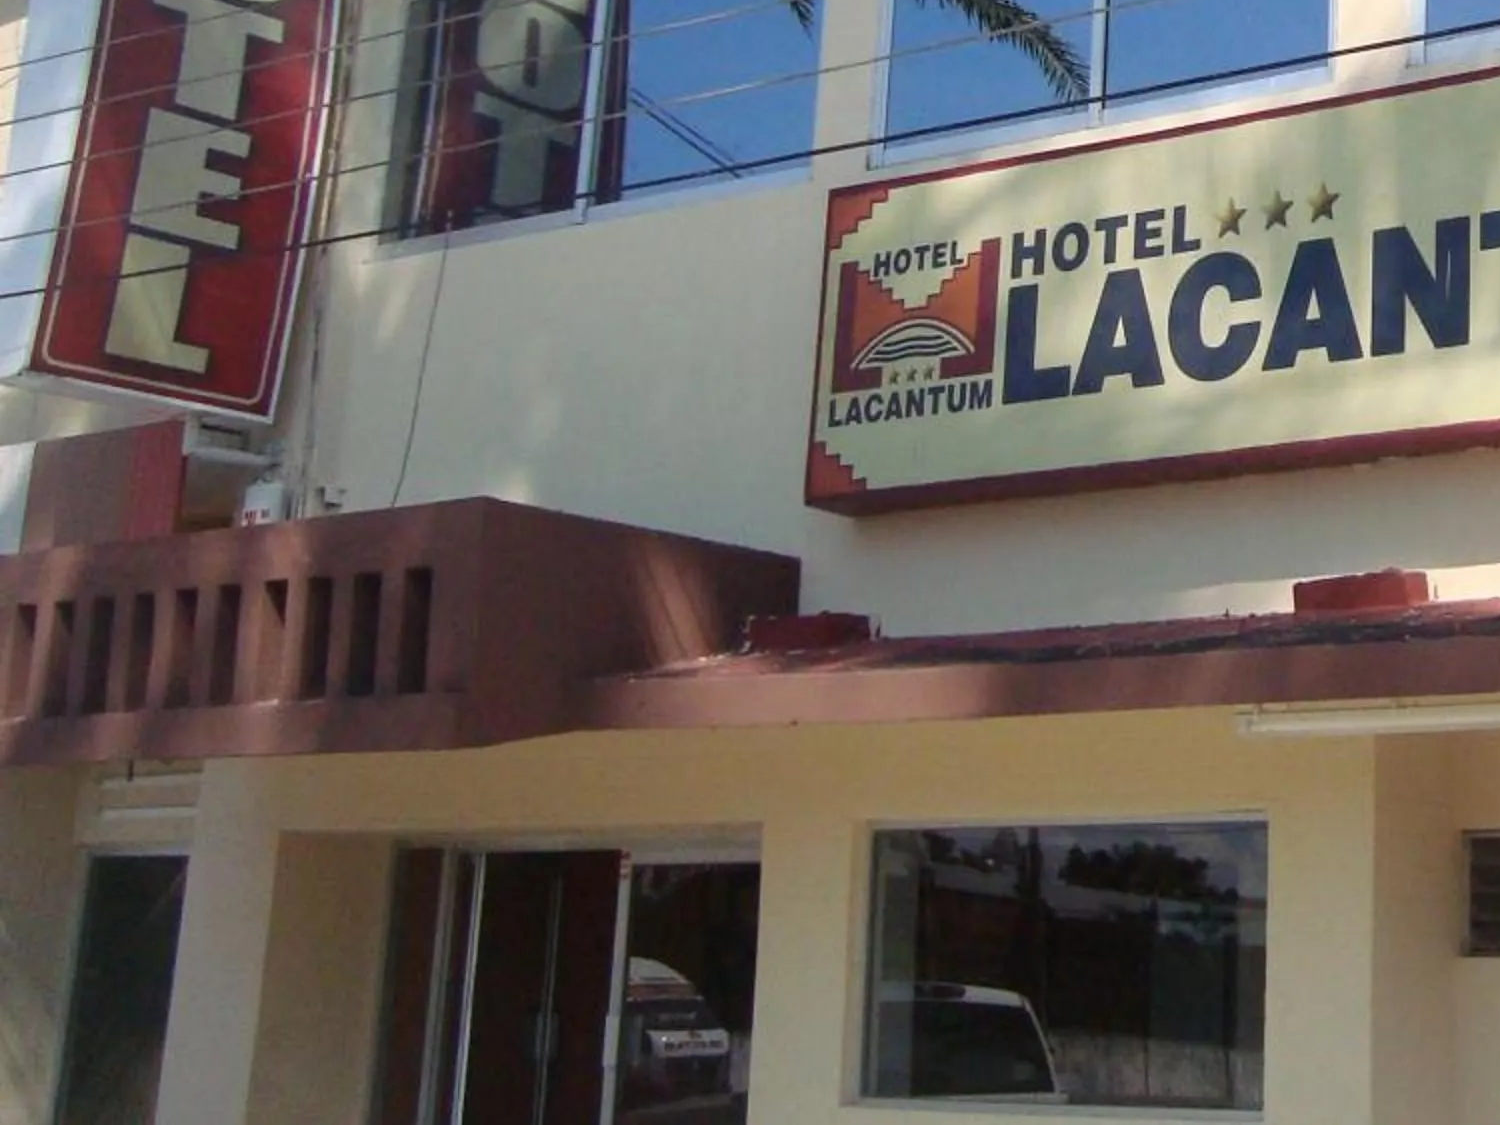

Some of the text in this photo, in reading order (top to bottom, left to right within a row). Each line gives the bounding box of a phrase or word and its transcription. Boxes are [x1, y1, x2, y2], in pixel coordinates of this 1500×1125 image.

[872, 240, 965, 278] HOTEL
[1010, 204, 1202, 280] HOTEL
[827, 378, 994, 428] LACANTUM
